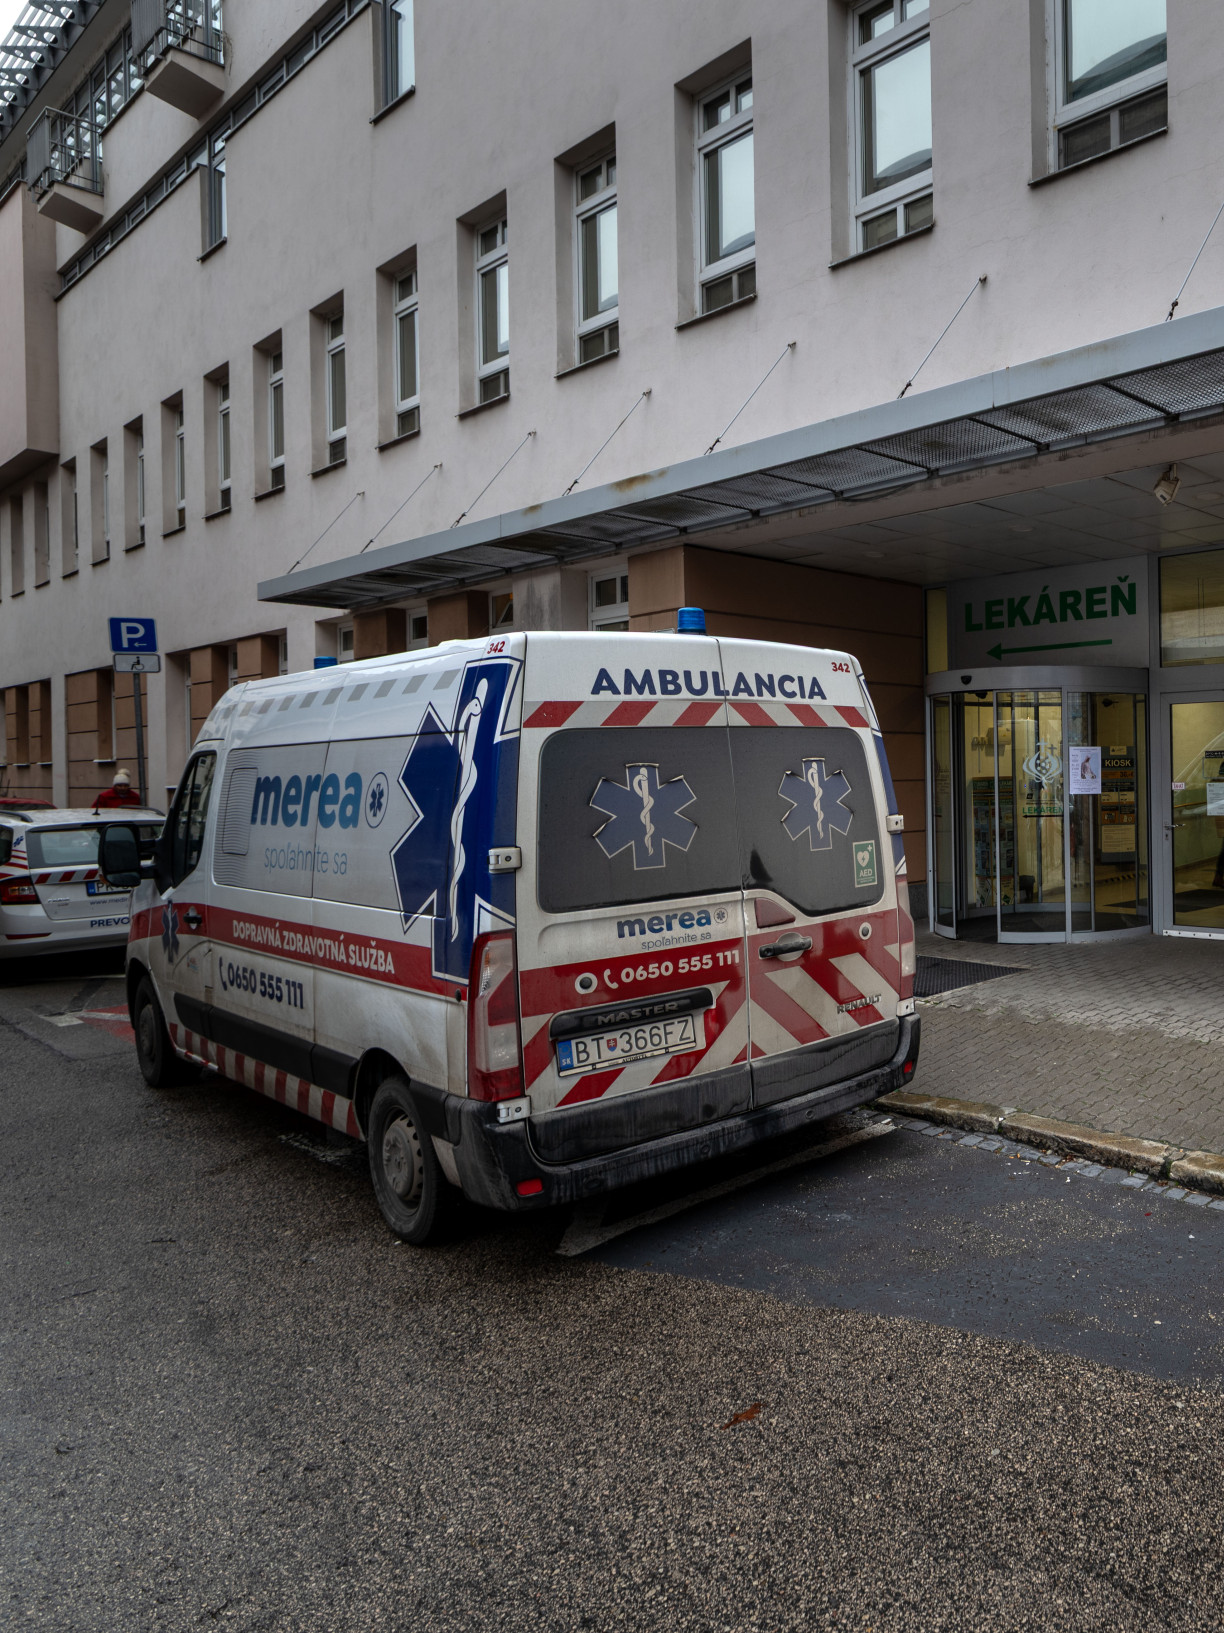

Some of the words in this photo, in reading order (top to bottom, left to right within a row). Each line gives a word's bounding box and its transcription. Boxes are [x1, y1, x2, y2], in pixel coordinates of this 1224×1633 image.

[965, 575, 1136, 632] LEKÁREŇ
[121, 622, 145, 648] P
[487, 640, 506, 655] 342
[831, 662, 851, 673] 342
[590, 667, 827, 700] AMBULANCIA
[251, 772, 363, 829] merea
[332, 852, 348, 875] sa
[859, 868, 873, 878] AED
[616, 909, 712, 938] merea
[232, 920, 282, 949] DOPRAVNÁ
[283, 931, 347, 963] ZDRAVOTNÁ
[349, 940, 395, 974] SLUŽBA
[641, 933, 698, 950] spoľahnite
[701, 932, 712, 941] sa
[620, 961, 673, 983] 0650
[678, 954, 713, 974] 555
[716, 950, 740, 966] 111
[227, 962, 257, 994] 0650
[260, 972, 283, 1003] 555
[285, 979, 304, 1009] 111
[597, 1001, 680, 1025] MASTER
[837, 994, 882, 1014] RENAULT
[562, 1057, 571, 1066] SK
[575, 1036, 604, 1064] BT
[619, 1019, 691, 1053] 366FZ
